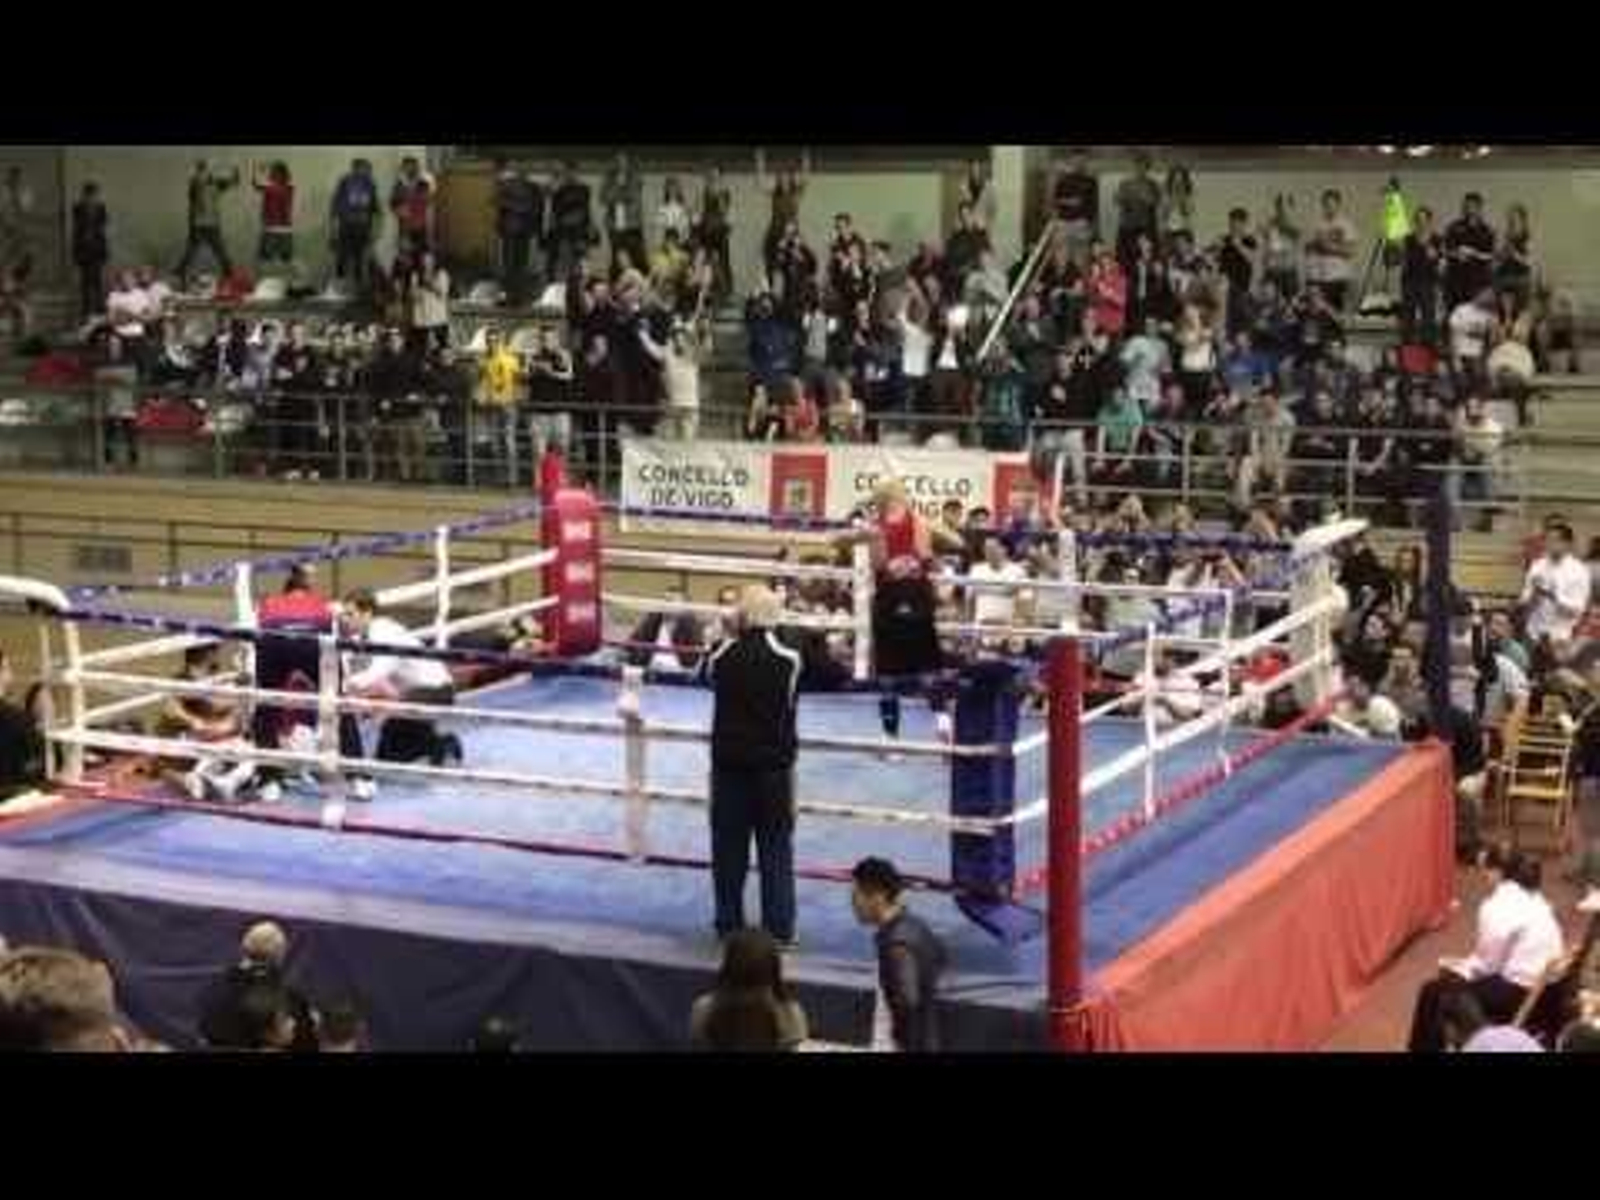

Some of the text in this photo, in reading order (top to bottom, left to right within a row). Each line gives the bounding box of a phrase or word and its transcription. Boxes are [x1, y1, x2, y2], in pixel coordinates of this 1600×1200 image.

[638, 463, 749, 488] CONCELLO
[854, 471, 972, 497] COCELLO
[651, 487, 735, 511] DE VIGO
